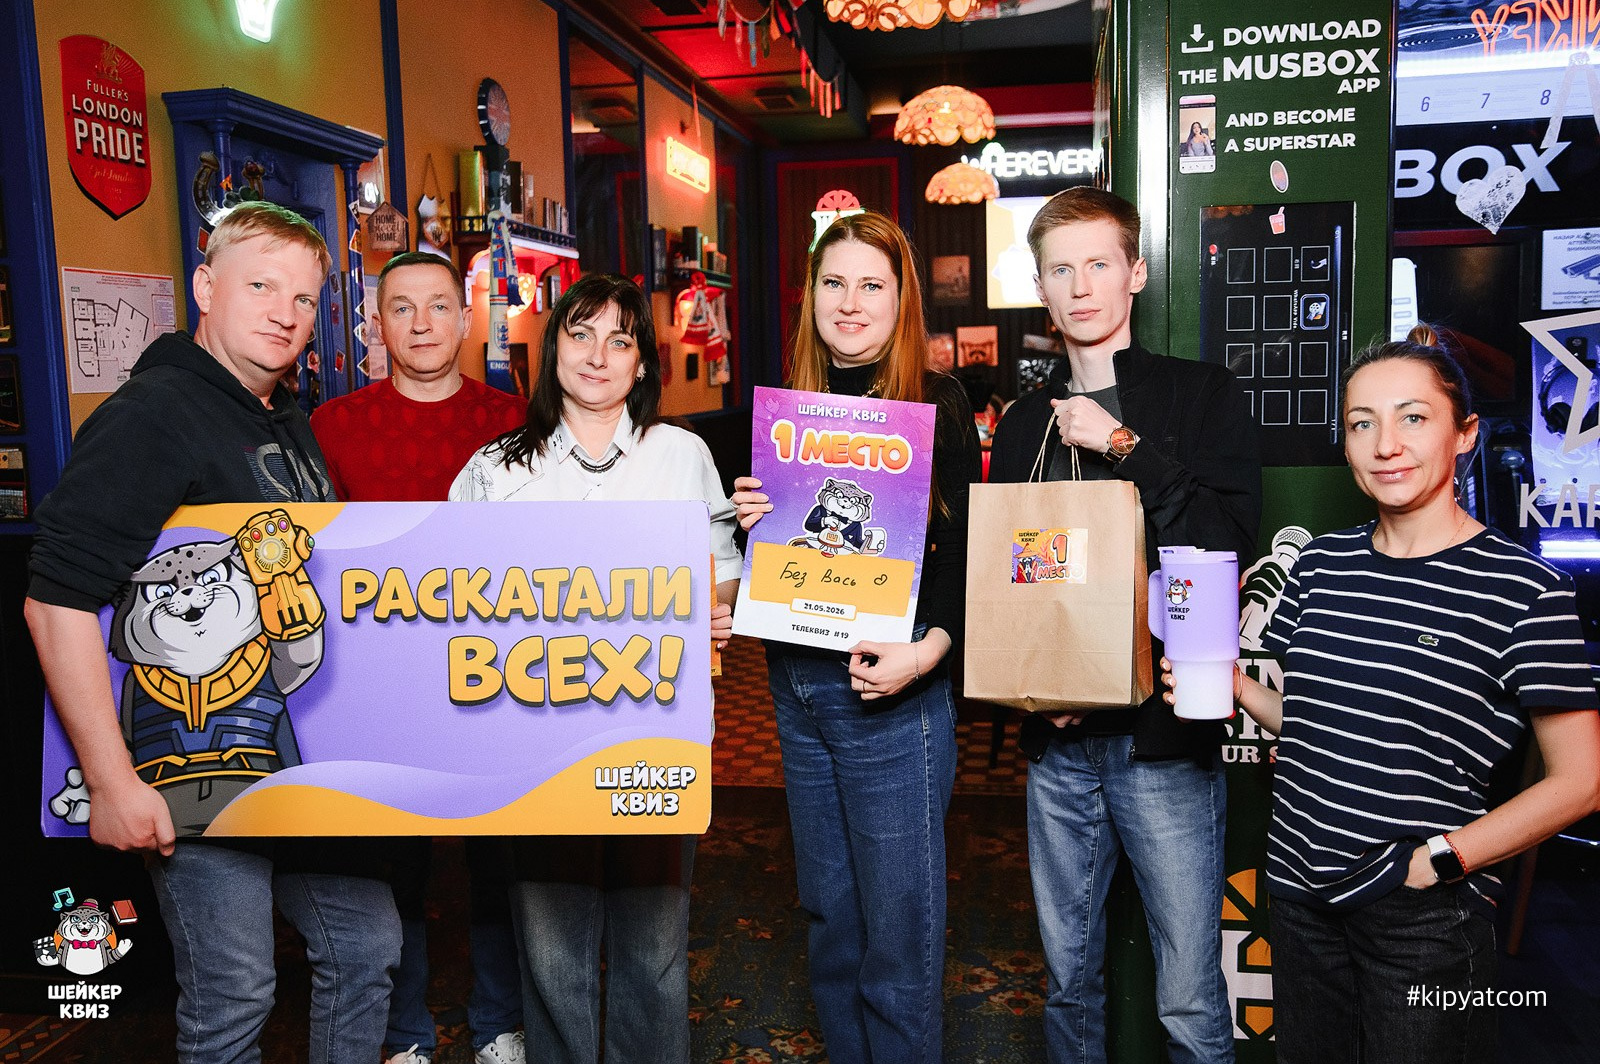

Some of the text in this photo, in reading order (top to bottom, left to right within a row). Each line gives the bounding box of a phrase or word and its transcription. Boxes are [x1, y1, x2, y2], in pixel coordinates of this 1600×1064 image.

[1224, 19, 1382, 46] DOWNLOAD
[1178, 48, 1381, 85] THE MUSBOX
[87, 79, 129, 102] FULLER'S
[1337, 78, 1381, 94] APP
[72, 93, 143, 127] LONDON
[1420, 89, 1552, 112] 6 7 8
[1225, 107, 1356, 128] AND BECOME
[74, 117, 146, 165] PRIDE
[1224, 132, 1356, 153] A SUPERSTAR
[375, 215, 396, 225] HOME
[376, 232, 397, 241] HOME
[798, 403, 887, 423] ШЕЙКЕР КВИЗ
[772, 421, 910, 471] 1 МЕСТО
[1052, 533, 1068, 564] 1
[779, 561, 808, 588] Без
[340, 566, 692, 623] РАСКАТАЛИ
[803, 602, 846, 616] 21.05.2026
[791, 624, 830, 636] ТЕЛЕКВИЗ
[448, 634, 685, 707] ВСЕХ!
[594, 761, 697, 790] ШЕЙКЕР
[610, 793, 680, 816] КВИЗ
